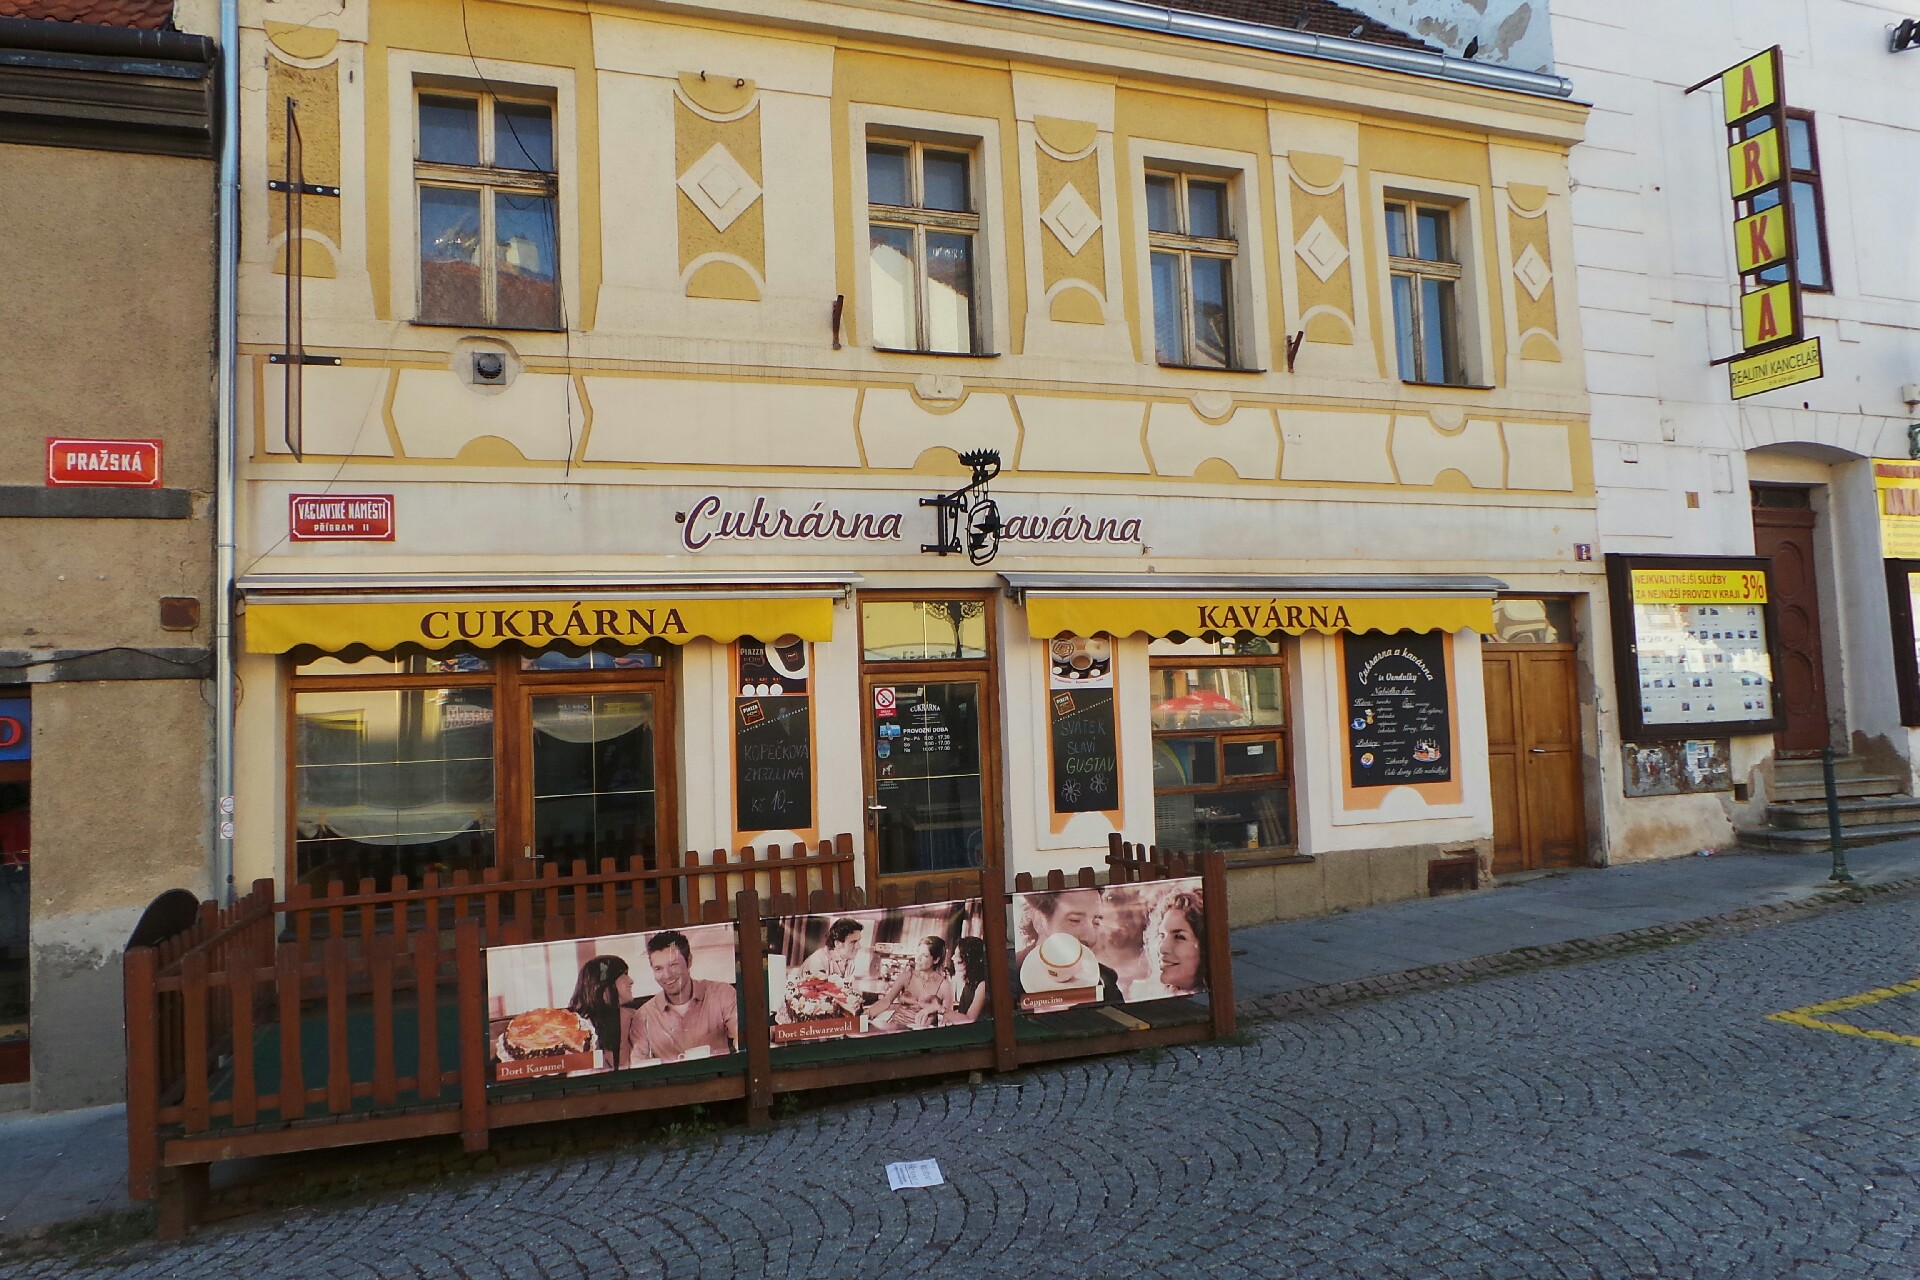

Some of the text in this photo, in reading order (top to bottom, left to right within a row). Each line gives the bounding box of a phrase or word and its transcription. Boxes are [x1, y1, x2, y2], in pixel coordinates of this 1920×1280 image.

[1740, 64, 1778, 341] ARKA
[1730, 345, 1819, 385] REALITNÍ KANCELÁŘ
[66, 449, 142, 471] PRAŽSKÁ
[298, 501, 386, 519] VÁCLAVSKÉ NÁMĚSTÍ
[313, 522, 354, 532] PŘÍBRAM
[682, 494, 1144, 551] Cukrárna avárna
[1697, 573, 1727, 585] SLUŽBY
[1741, 574, 1764, 599] 3%
[1682, 589, 1711, 599] PROVIZI
[1719, 589, 1741, 599] KRAJI
[420, 600, 689, 640] CUKRÁRNA
[1197, 598, 1352, 629] KAVÁRNA
[740, 648, 764, 656] PIAZZA
[1394, 648, 1401, 656] a
[744, 738, 809, 761] KOPEČKOVÁ
[744, 766, 804, 782] ZMRZLINA
[1066, 757, 1115, 775] GUSTAV
[1023, 996, 1063, 1007] Cappucino
[778, 1021, 852, 1039] Dort Schwarzwald
[501, 1059, 565, 1077] Dort Karamel
